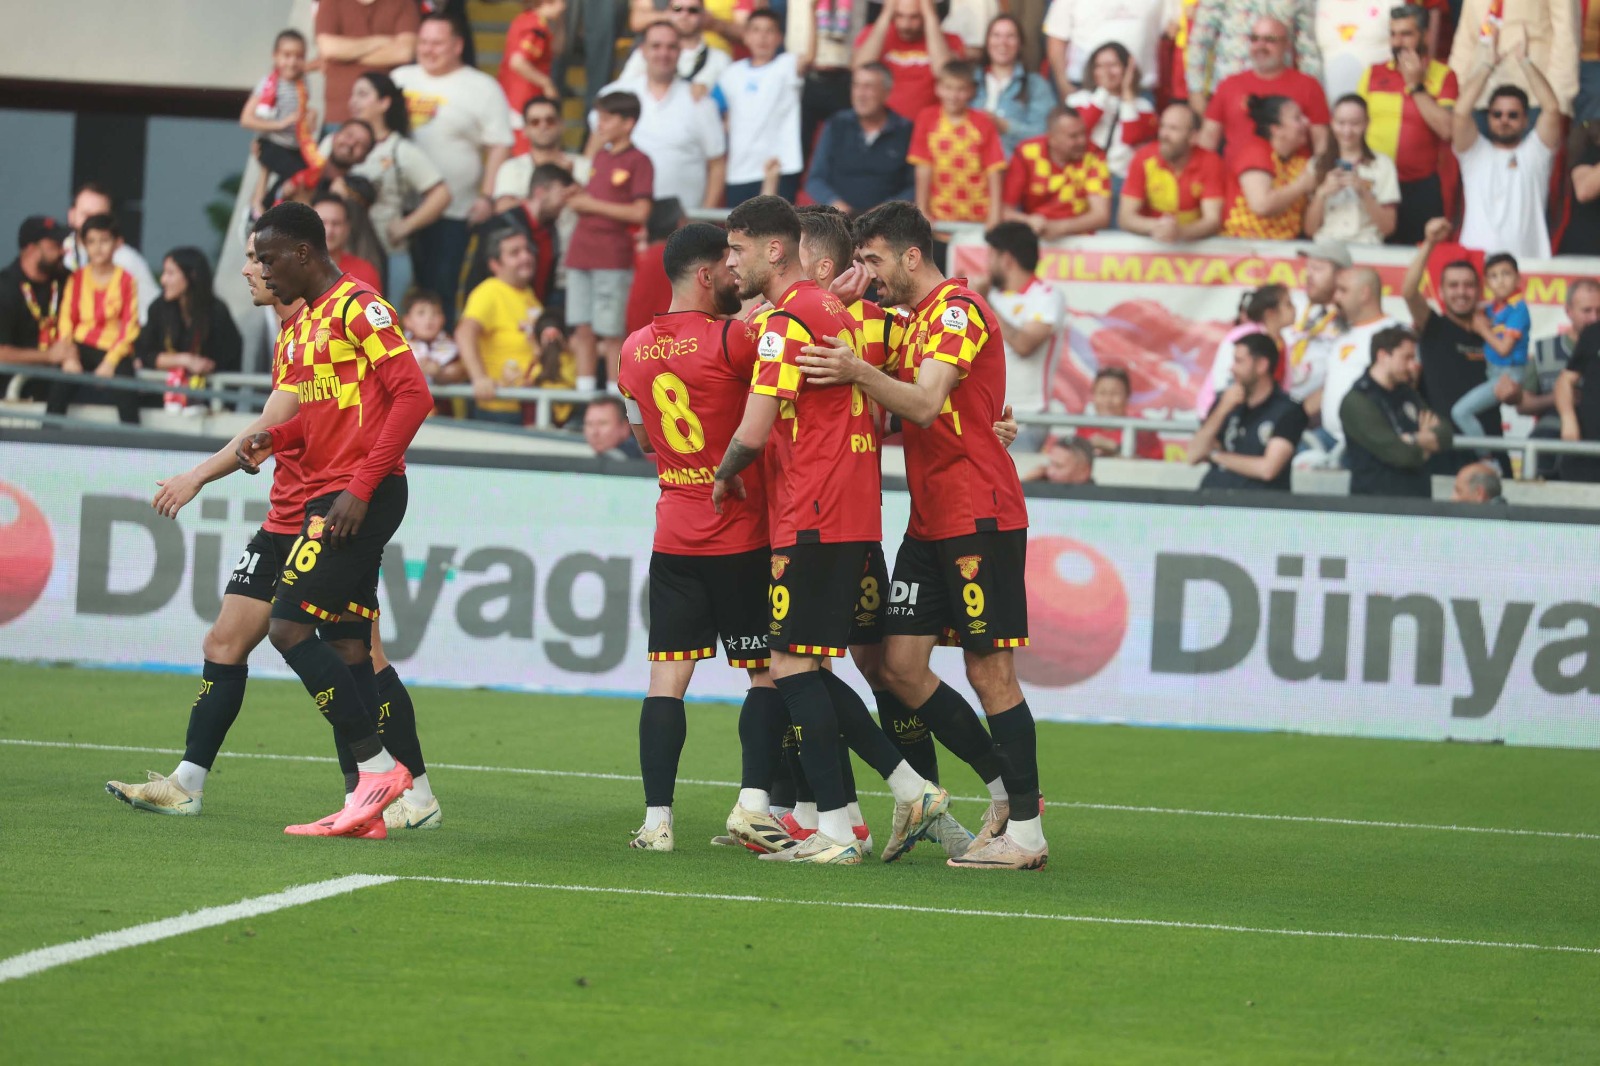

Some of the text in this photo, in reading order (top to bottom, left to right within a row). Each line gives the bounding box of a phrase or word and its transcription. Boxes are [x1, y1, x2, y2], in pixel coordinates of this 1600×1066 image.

[1035, 252, 1307, 287] YILMAYACA
[652, 372, 705, 454] 8
[285, 535, 322, 573] 16
[769, 583, 790, 621] 9
[888, 580, 920, 605] DI
[962, 582, 985, 618] 9
[886, 606, 915, 616] ORTA
